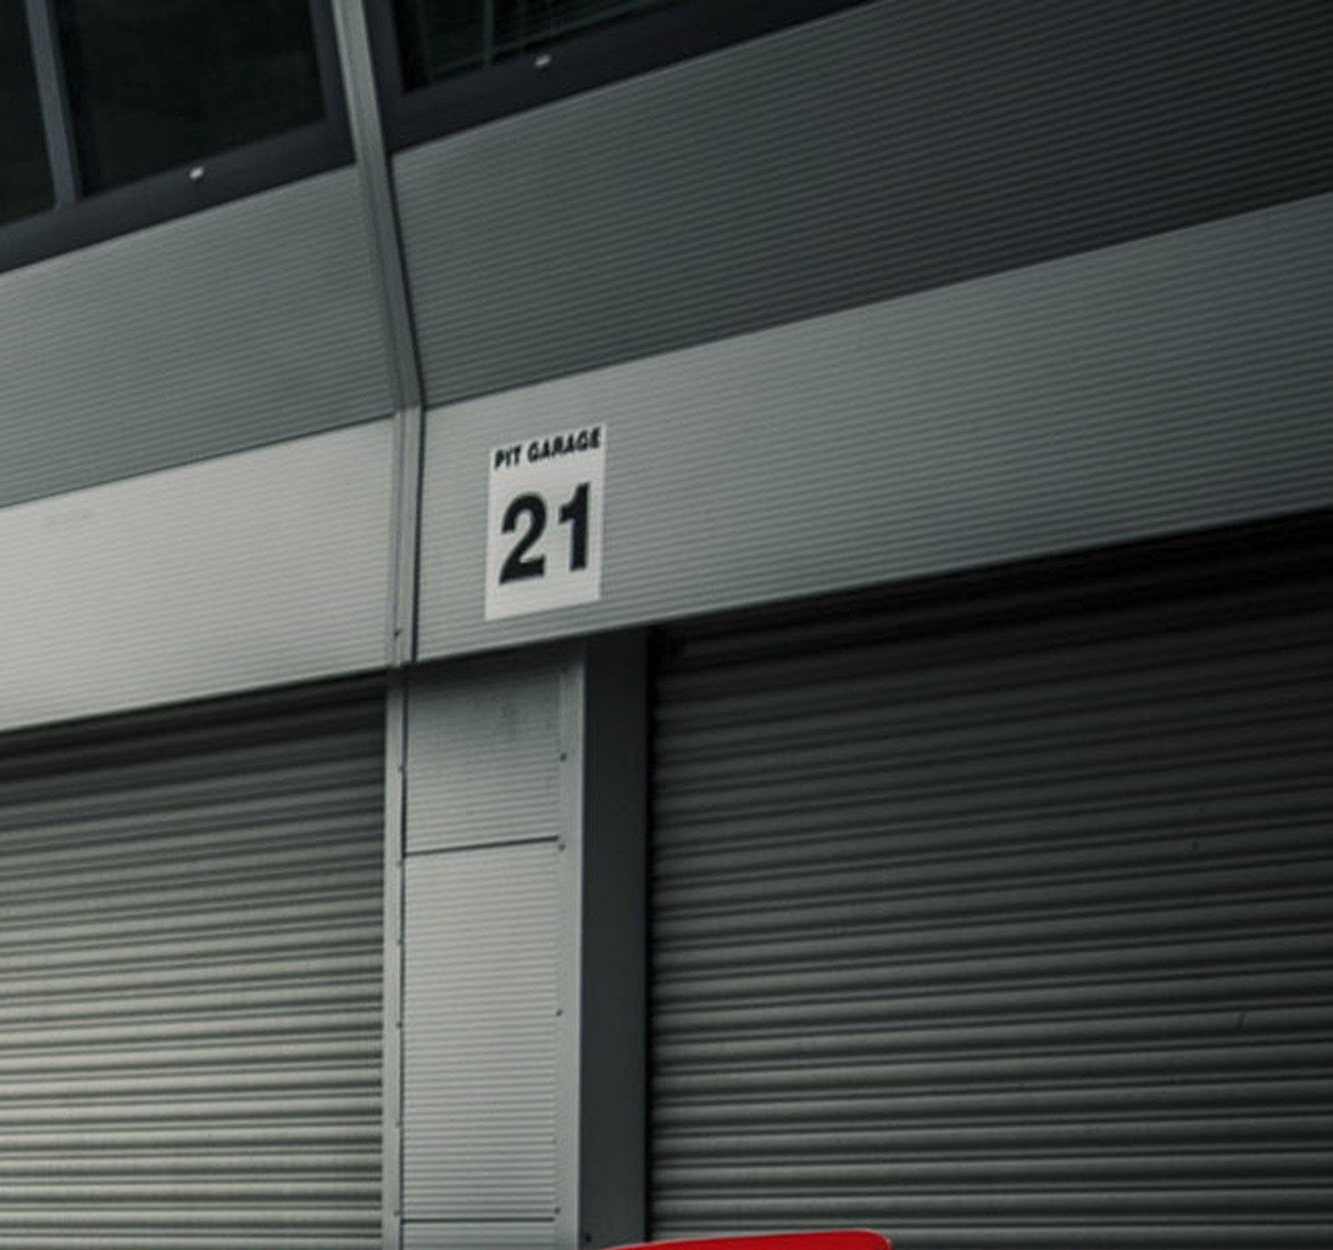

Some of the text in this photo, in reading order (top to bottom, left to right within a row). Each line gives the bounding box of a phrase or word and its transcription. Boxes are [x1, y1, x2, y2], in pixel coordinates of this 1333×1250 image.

[494, 427, 600, 469] PIT GARAGE
[499, 482, 590, 585] 21
